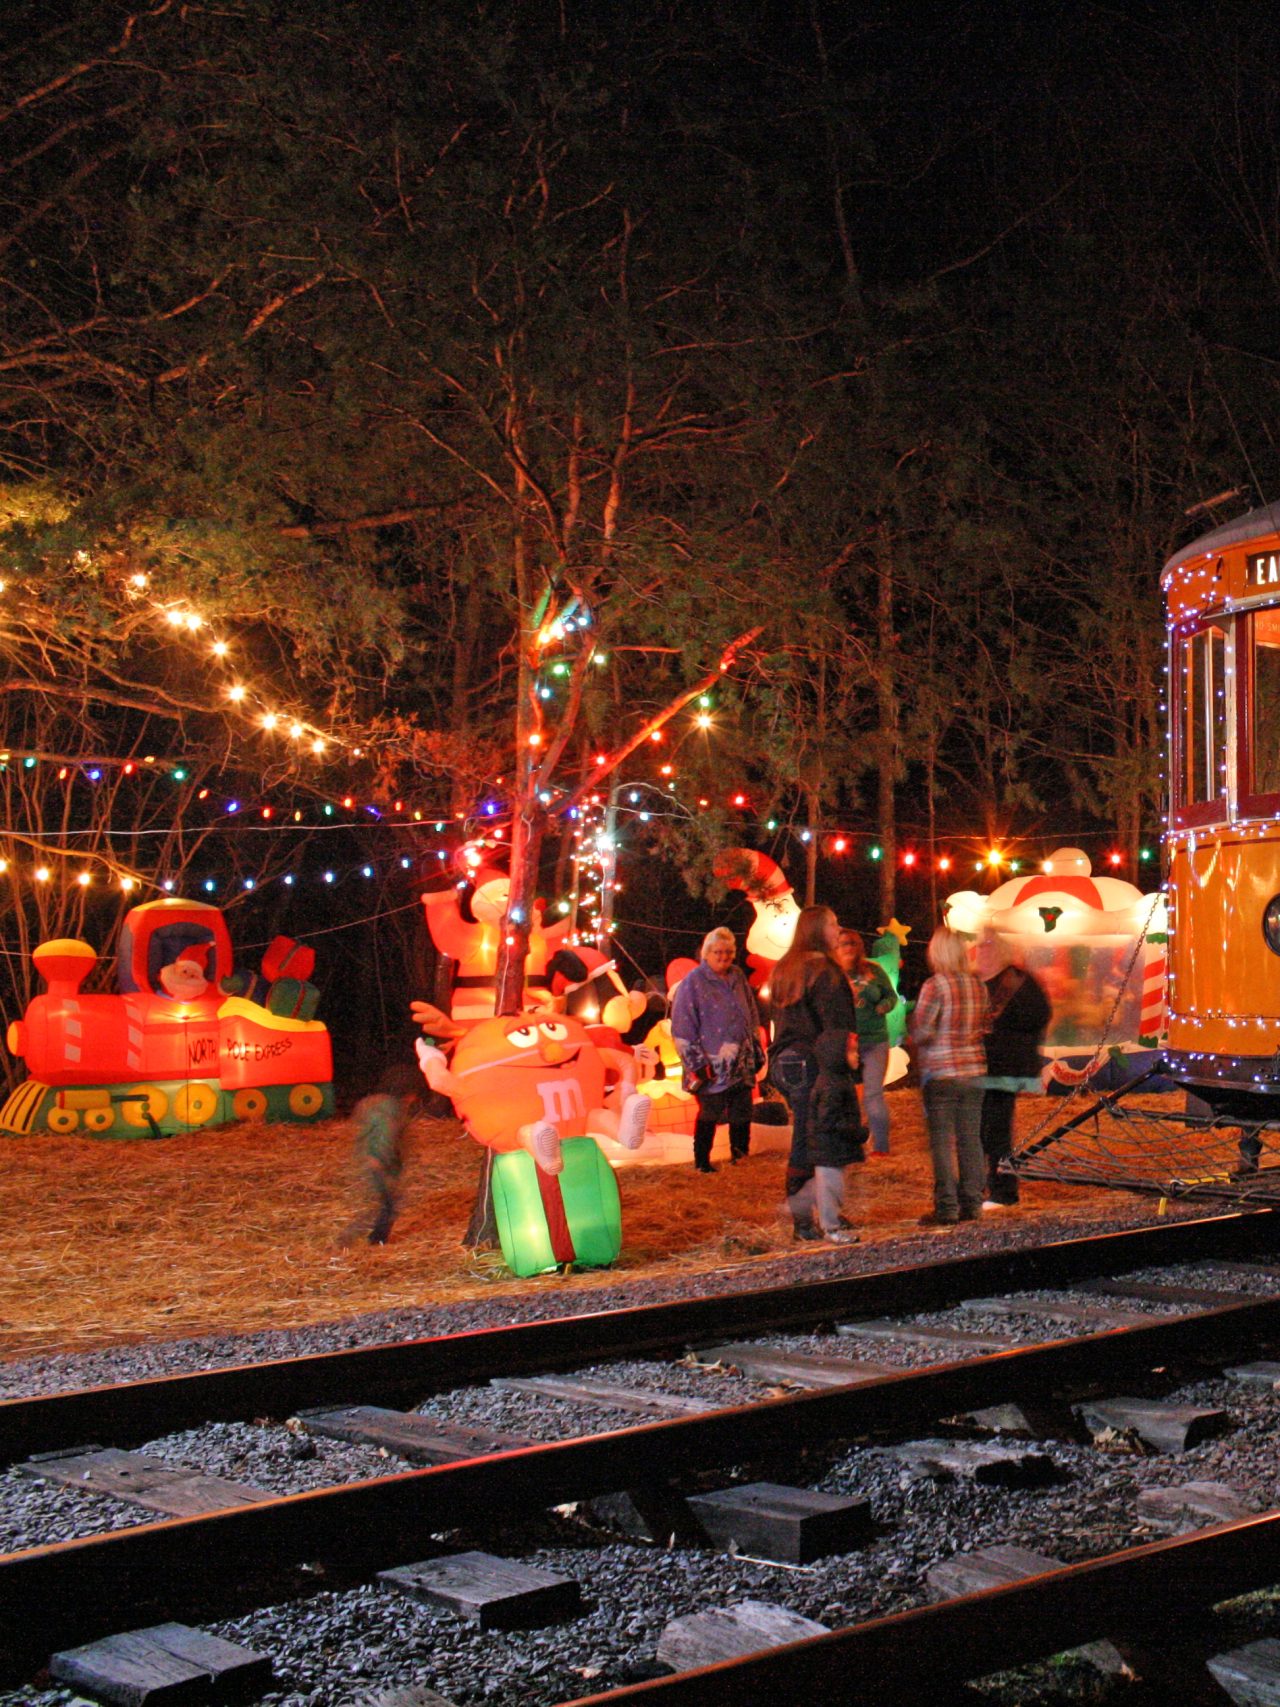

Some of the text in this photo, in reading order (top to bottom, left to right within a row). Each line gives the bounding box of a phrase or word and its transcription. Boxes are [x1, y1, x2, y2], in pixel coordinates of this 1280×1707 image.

[188, 1037, 293, 1067] NORTH POLE EXPRESS
